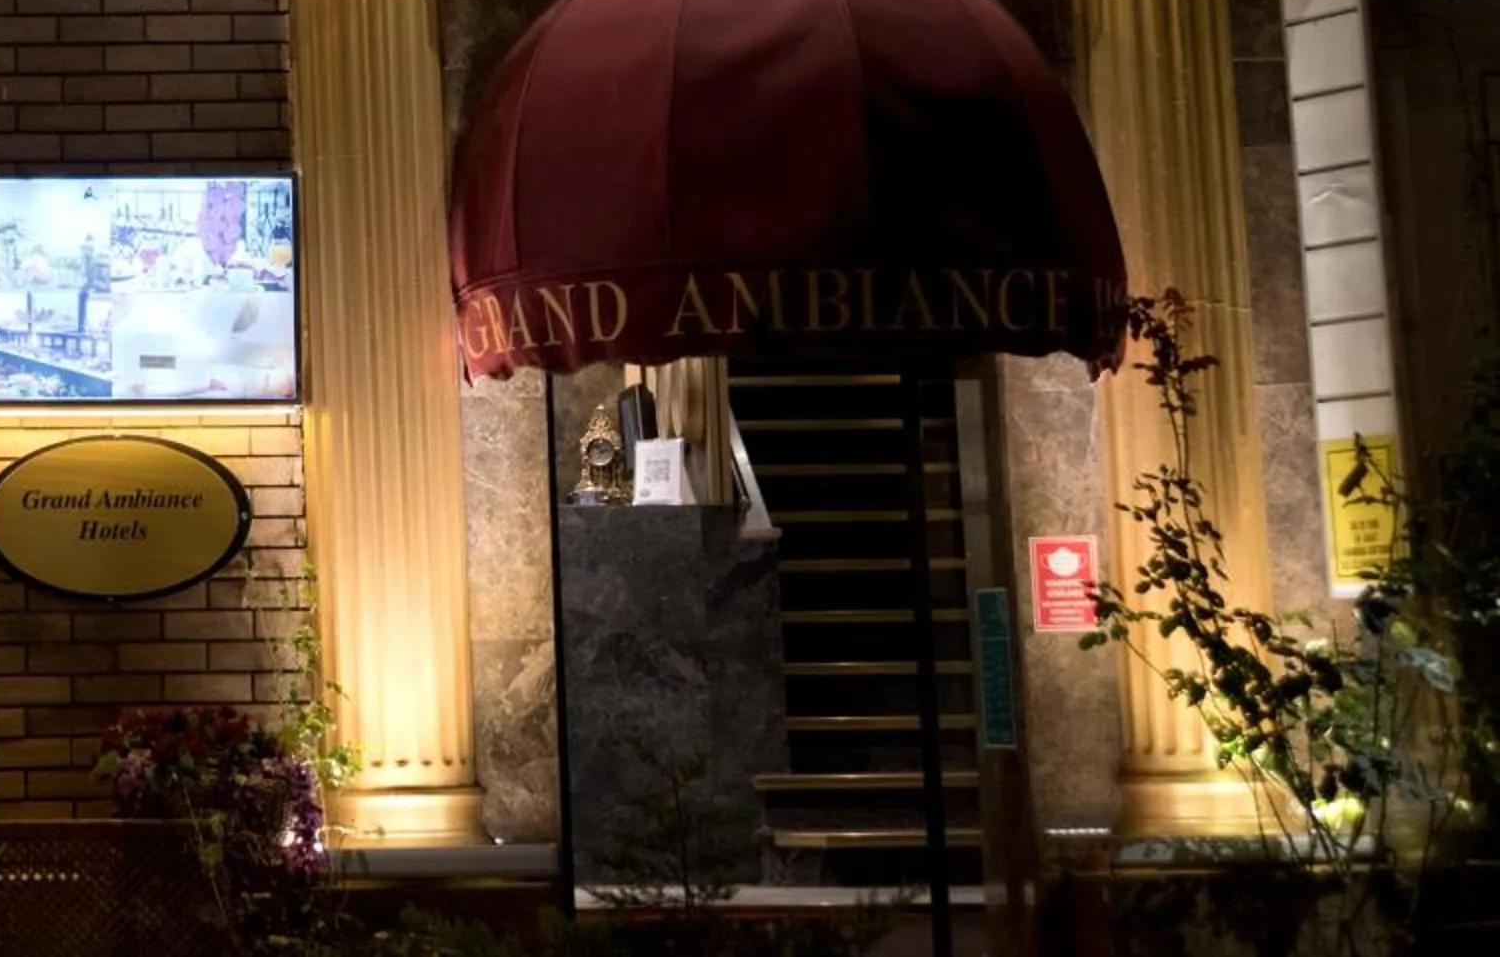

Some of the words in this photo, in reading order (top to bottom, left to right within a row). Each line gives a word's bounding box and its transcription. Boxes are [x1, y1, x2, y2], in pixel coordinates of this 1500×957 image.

[463, 279, 628, 359] GRAND
[664, 266, 1071, 336] AMBIANCE
[21, 489, 90, 511] Grand
[95, 490, 204, 511] Ambiance
[78, 519, 148, 541] Hotels
